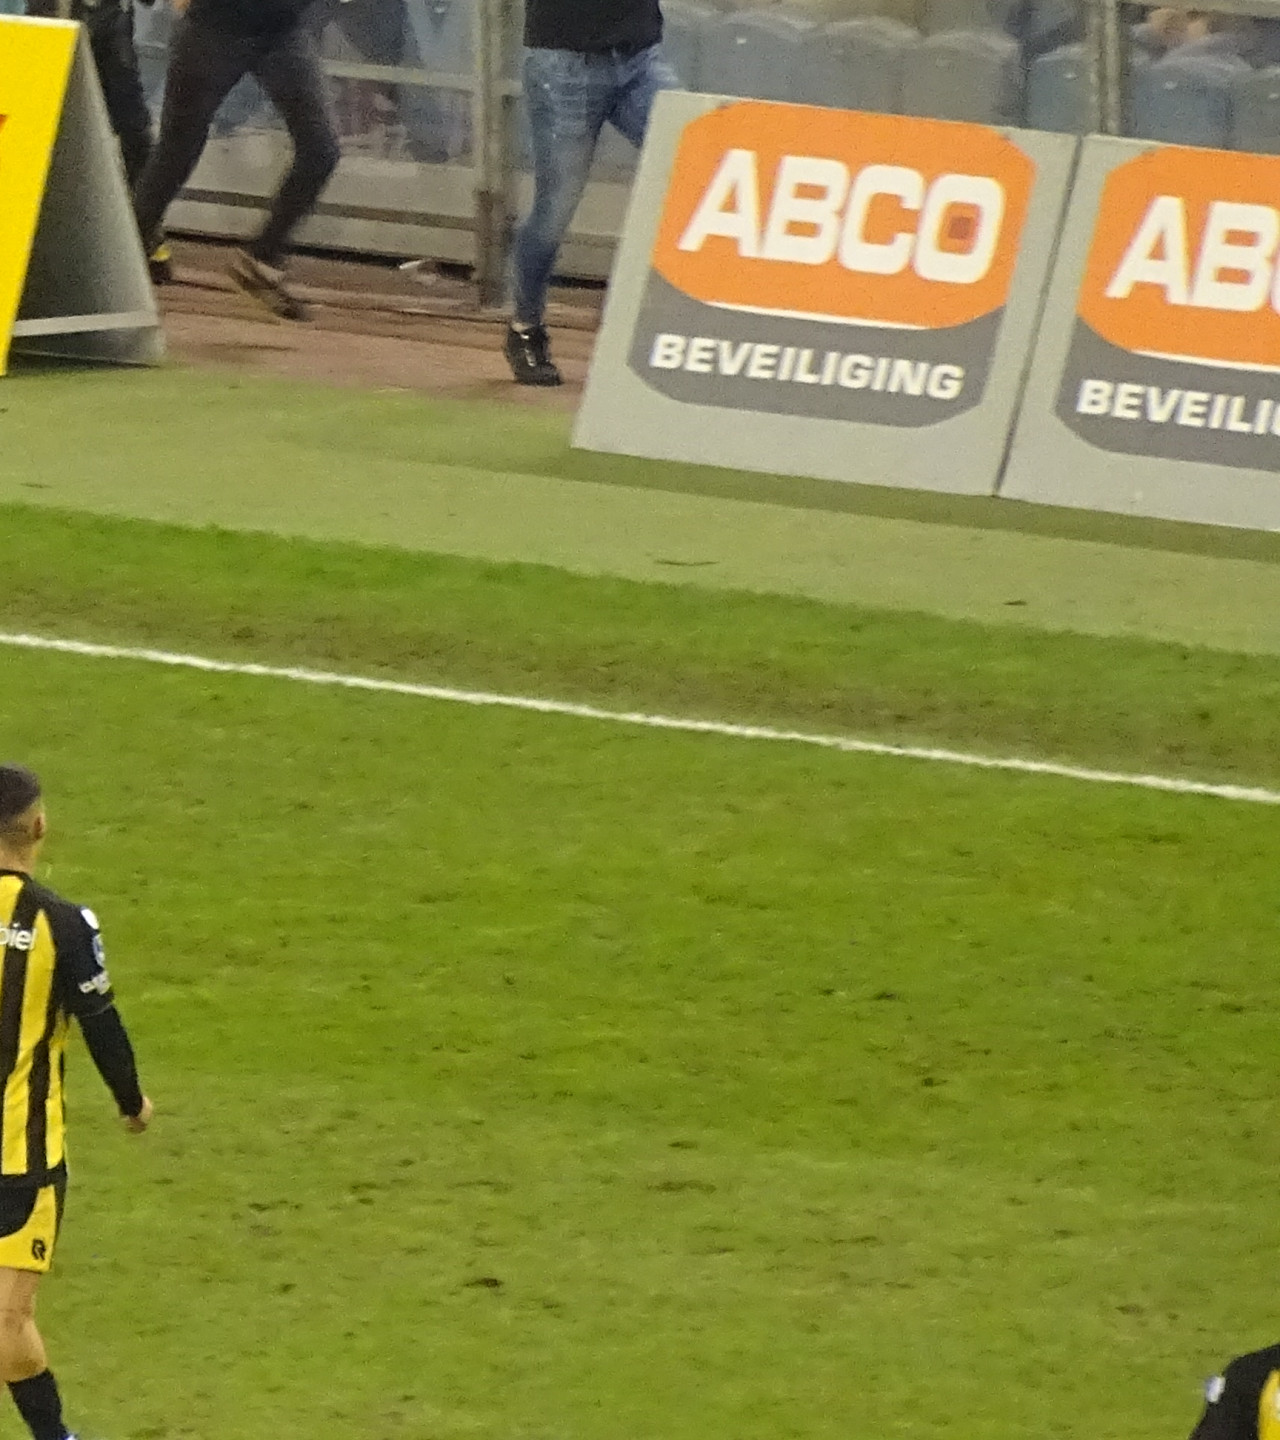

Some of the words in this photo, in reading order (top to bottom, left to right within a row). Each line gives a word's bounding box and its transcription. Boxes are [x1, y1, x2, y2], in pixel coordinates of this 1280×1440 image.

[678, 148, 1005, 284] ABCO
[1105, 194, 1280, 316] AB
[649, 333, 966, 399] BEVEILIGING
[1076, 378, 1280, 438] BEVEILI
